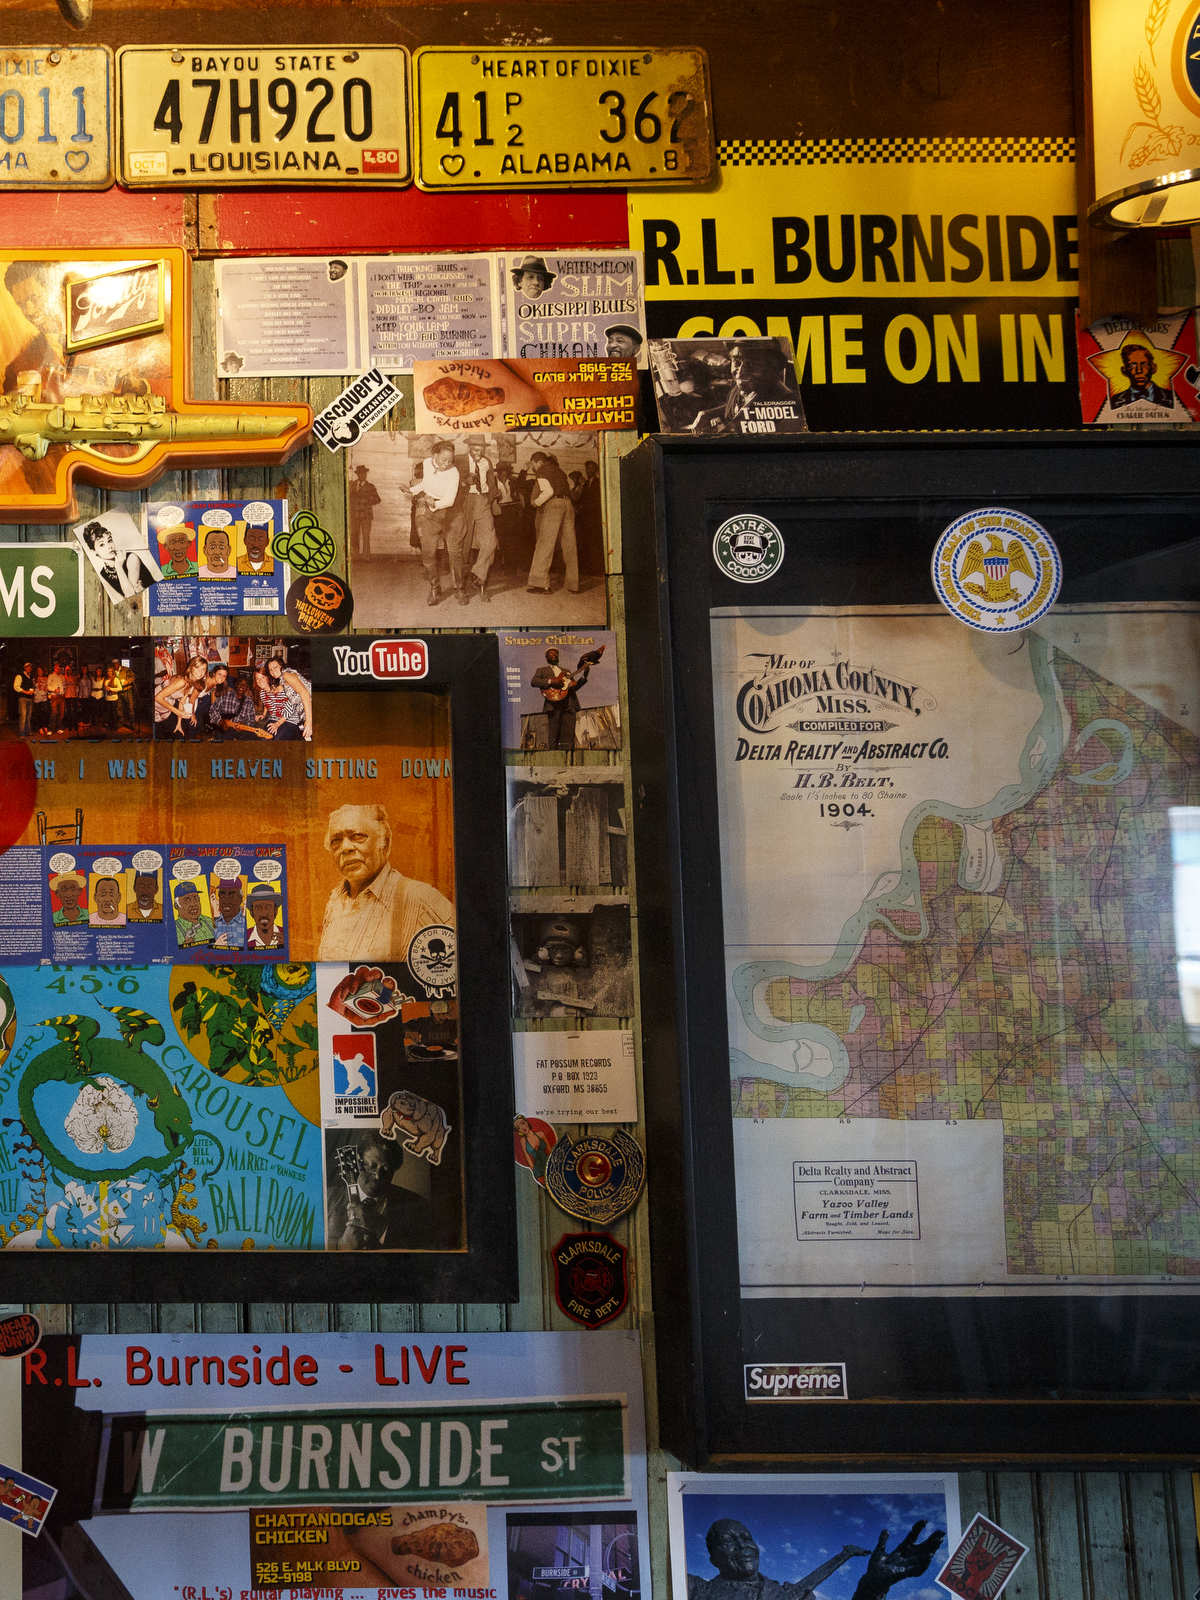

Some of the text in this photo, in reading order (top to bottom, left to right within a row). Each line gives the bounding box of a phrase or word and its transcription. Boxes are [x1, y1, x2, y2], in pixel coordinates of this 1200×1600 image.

[191, 55, 336, 73] BAYOU STATE
[482, 58, 641, 78] HEART OF DIXIE
[153, 77, 374, 145] 47H920
[190, 151, 342, 174] LOUISIANA
[642, 213, 1079, 287] R.L. BURNSIDE
[396, 265, 434, 273] TRUCKING
[556, 260, 634, 275] WATERMELON
[385, 281, 422, 289] THE TRIP
[560, 274, 635, 297] SLIM
[518, 299, 636, 319] OKIESIPPI BLUES
[375, 322, 450, 332] KEEP YOUR LAMP
[379, 330, 477, 341] TRIMMED AND BURNING
[519, 321, 600, 342] SUPER
[579, 362, 632, 373] 752-9198
[358, 386, 393, 419] CHANNEL
[564, 395, 634, 410] CHICKEN
[504, 410, 635, 427] CHATTANOOGA'S
[741, 406, 799, 420] T-MODEL
[740, 420, 777, 434] FORD
[940, 516, 1054, 621] THE GREAT SEAL OF THE STATE OF MISSISSIPPI
[294, 599, 335, 627] HALLOWEEN
[298, 611, 326, 630] PARTY
[335, 647, 422, 673] YouTube
[736, 658, 922, 734] COAHOMA COUNTY,
[816, 695, 871, 714] MISS.
[802, 721, 882, 731] COMPILED FOR
[735, 737, 950, 766] DELTA REALTY AND ABSTRACT CO.
[834, 763, 852, 772] BY
[536, 1058, 612, 1069] FAT POSSUM RECORDS
[161, 1045, 310, 1171] CAROUSEL
[335, 1097, 377, 1107] IMPOSSIBLE
[335, 1105, 377, 1114] IS NOTHING!
[565, 1140, 623, 1172] CLARKSDALE
[798, 1165, 912, 1178] Delta Realty and Abstract
[578, 1181, 617, 1200] POLICE
[833, 1176, 876, 1188] Company
[208, 1176, 316, 1250] BALLROOM
[822, 1199, 890, 1210] Yazoo Valley
[801, 1210, 829, 1220] Farm
[843, 1210, 879, 1219] Timber
[881, 1209, 914, 1220] Lands
[558, 1240, 621, 1266] CLARKSDALE
[568, 1297, 620, 1319] FIRE DEPT.
[24, 1348, 103, 1388] R.L.
[126, 1345, 319, 1388] Burnside
[374, 1343, 470, 1387] LIVE
[748, 1367, 842, 1396] Supreme
[122, 1418, 582, 1494] W BURNSIDE ST
[255, 1512, 393, 1529] CHATTANOOGA'S
[255, 1529, 328, 1545] CHICKEN
[256, 1560, 361, 1574] 526 E. MLK BLVD
[407, 1562, 463, 1584] chicken
[540, 1568, 571, 1577] BURNSIDE
[256, 1571, 314, 1585] 752-9198
